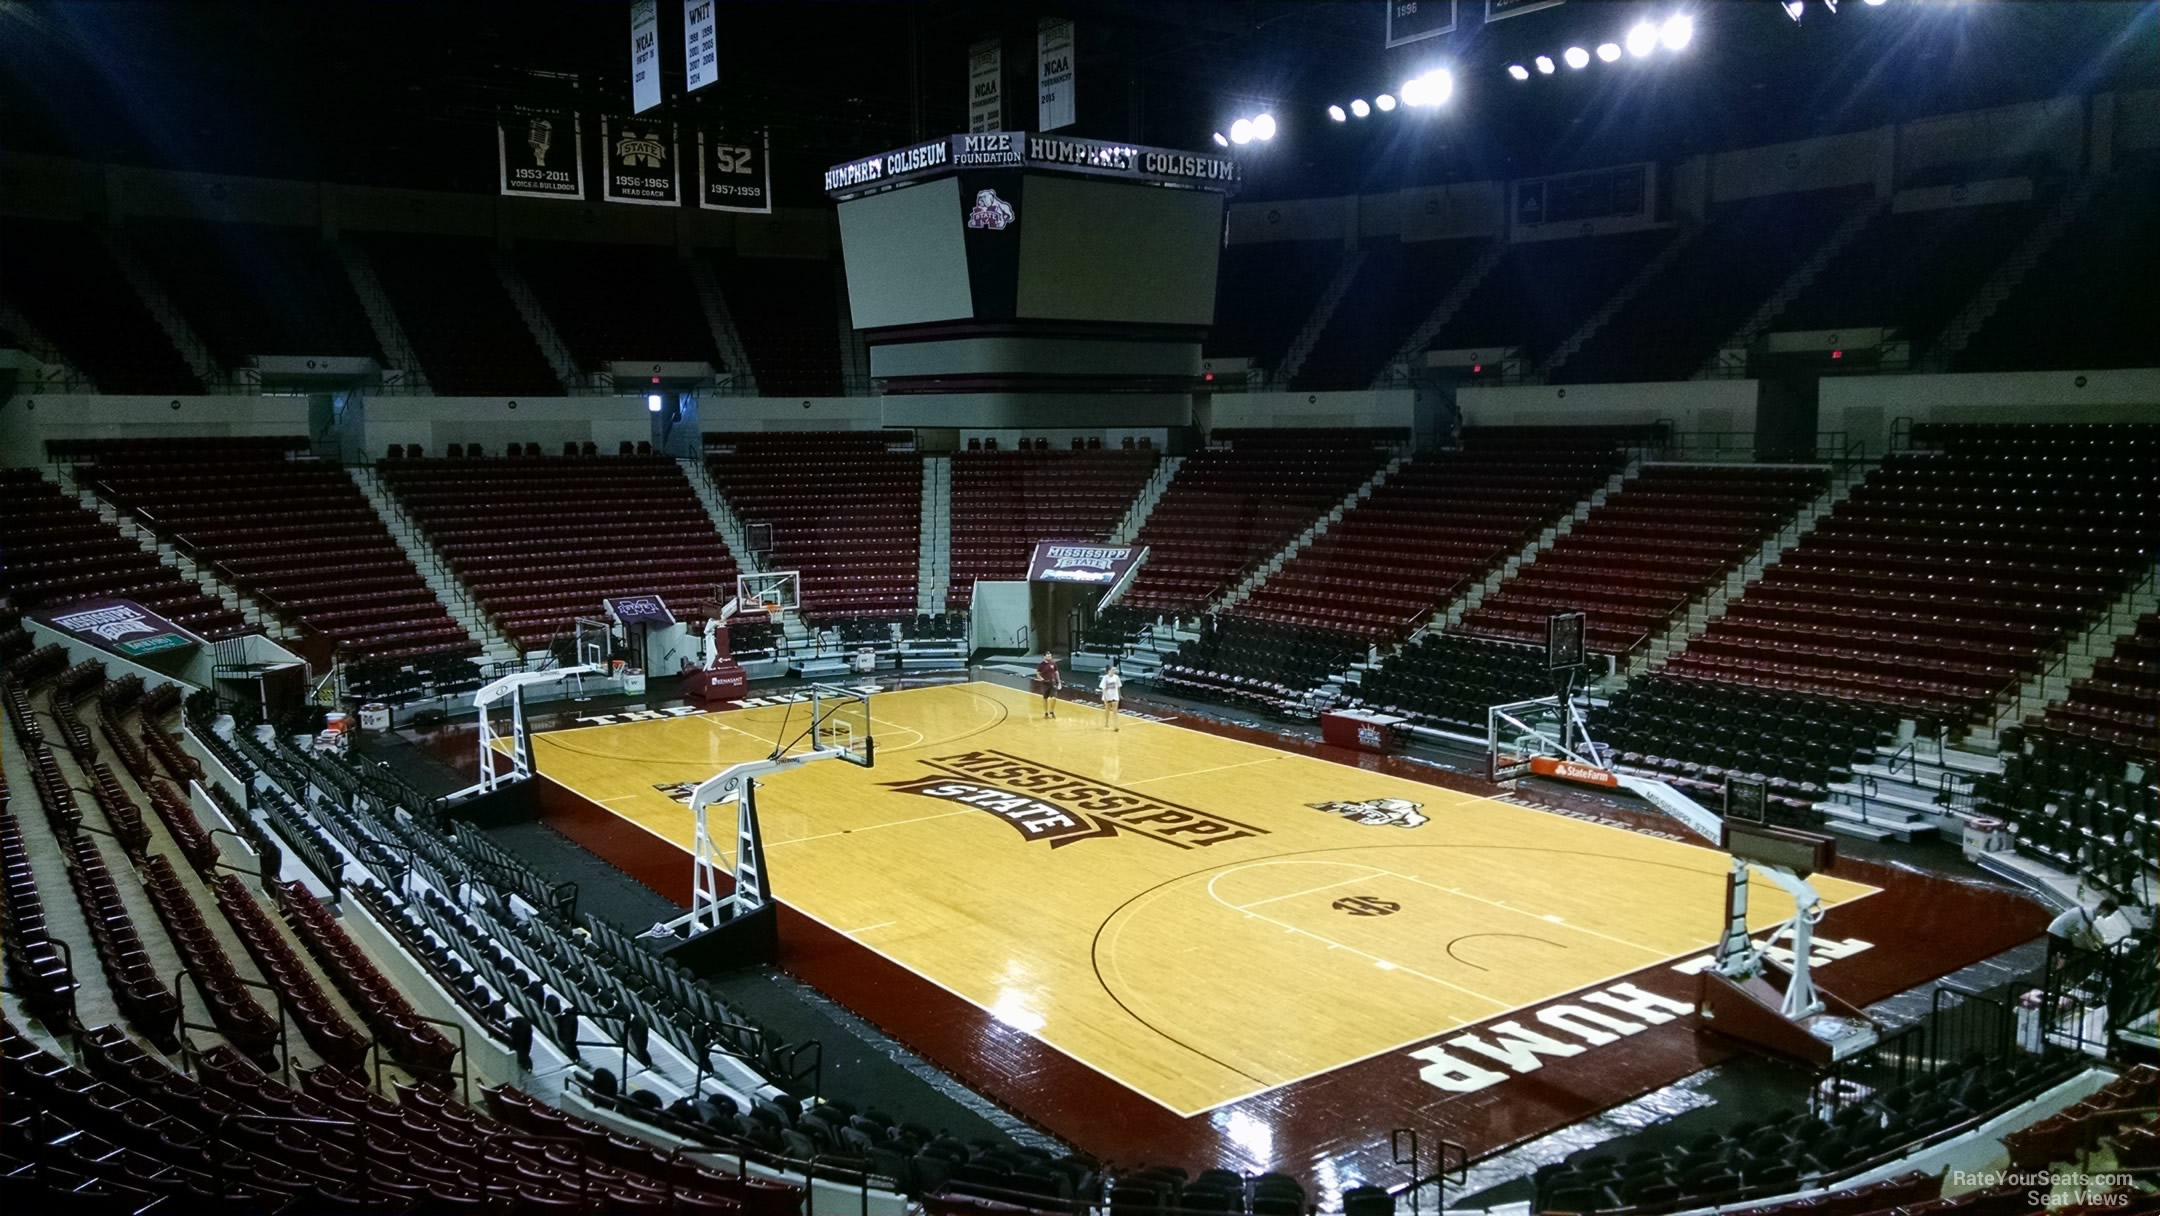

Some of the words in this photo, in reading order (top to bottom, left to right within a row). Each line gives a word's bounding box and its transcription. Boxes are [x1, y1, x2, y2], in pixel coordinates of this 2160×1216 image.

[689, 1, 710, 26] WNIT
[1397, 2, 1418, 18] 1996
[636, 31, 654, 54] NCAA
[1044, 56, 1069, 76] NCAA
[975, 80, 997, 98] NCAA
[624, 142, 659, 157] STATE
[965, 135, 1010, 151] MIZE
[717, 146, 752, 175] 52
[824, 157, 883, 191] HUMPHREY
[887, 141, 947, 176] COLISEUM
[954, 151, 1021, 166] FOUNDATION
[1030, 138, 1139, 170] HUMPHREY
[1146, 152, 1233, 181] COLISEUM
[515, 168, 570, 182] 1953-2011
[615, 175, 669, 189] 1956-1965
[511, 180, 532, 189] VOICE
[539, 182, 575, 192] BULLDOGS
[622, 188, 641, 197] HEAD
[642, 189, 664, 198] COACH
[711, 184, 761, 197] 1957-1959
[975, 212, 997, 220] STATE
[1047, 547, 1130, 560] MISSISSIPPI
[1066, 559, 1103, 568] STATE
[56, 607, 142, 630] MISSISSIPPI
[103, 622, 138, 637] STATE
[576, 706, 708, 725] THE
[931, 751, 1257, 847] MISSISSIPPI
[922, 784, 1075, 834] STATE
[1646, 790, 1693, 825] MISSISSIPPI
[1694, 822, 1720, 844] STATE
[1409, 982, 1695, 1092] HUMP
